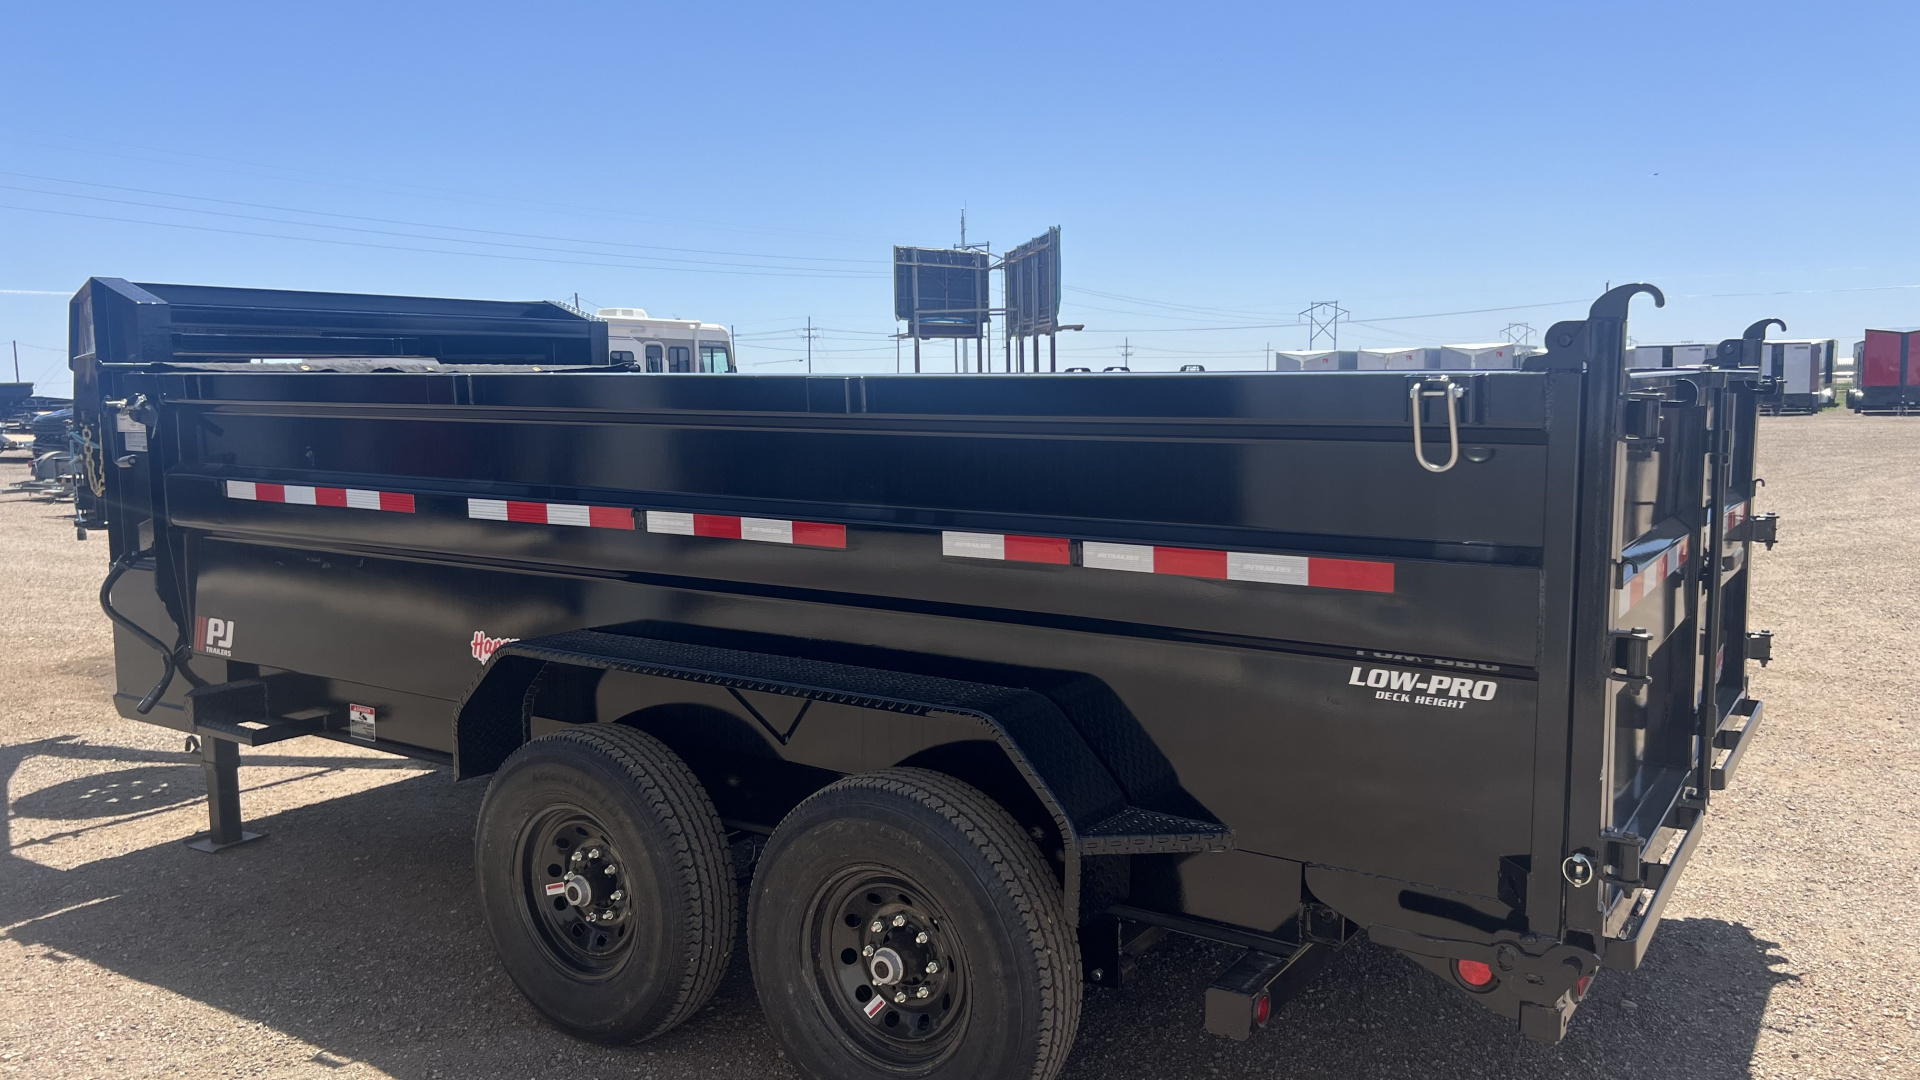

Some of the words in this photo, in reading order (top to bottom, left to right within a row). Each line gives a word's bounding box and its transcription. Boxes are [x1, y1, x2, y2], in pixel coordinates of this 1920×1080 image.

[206, 617, 235, 649] PJ
[205, 646, 232, 657] TRAILERS
[1348, 666, 1498, 701] LOW-PRO
[1375, 690, 1411, 703] DECK
[1414, 695, 1467, 709] HEIGHT
